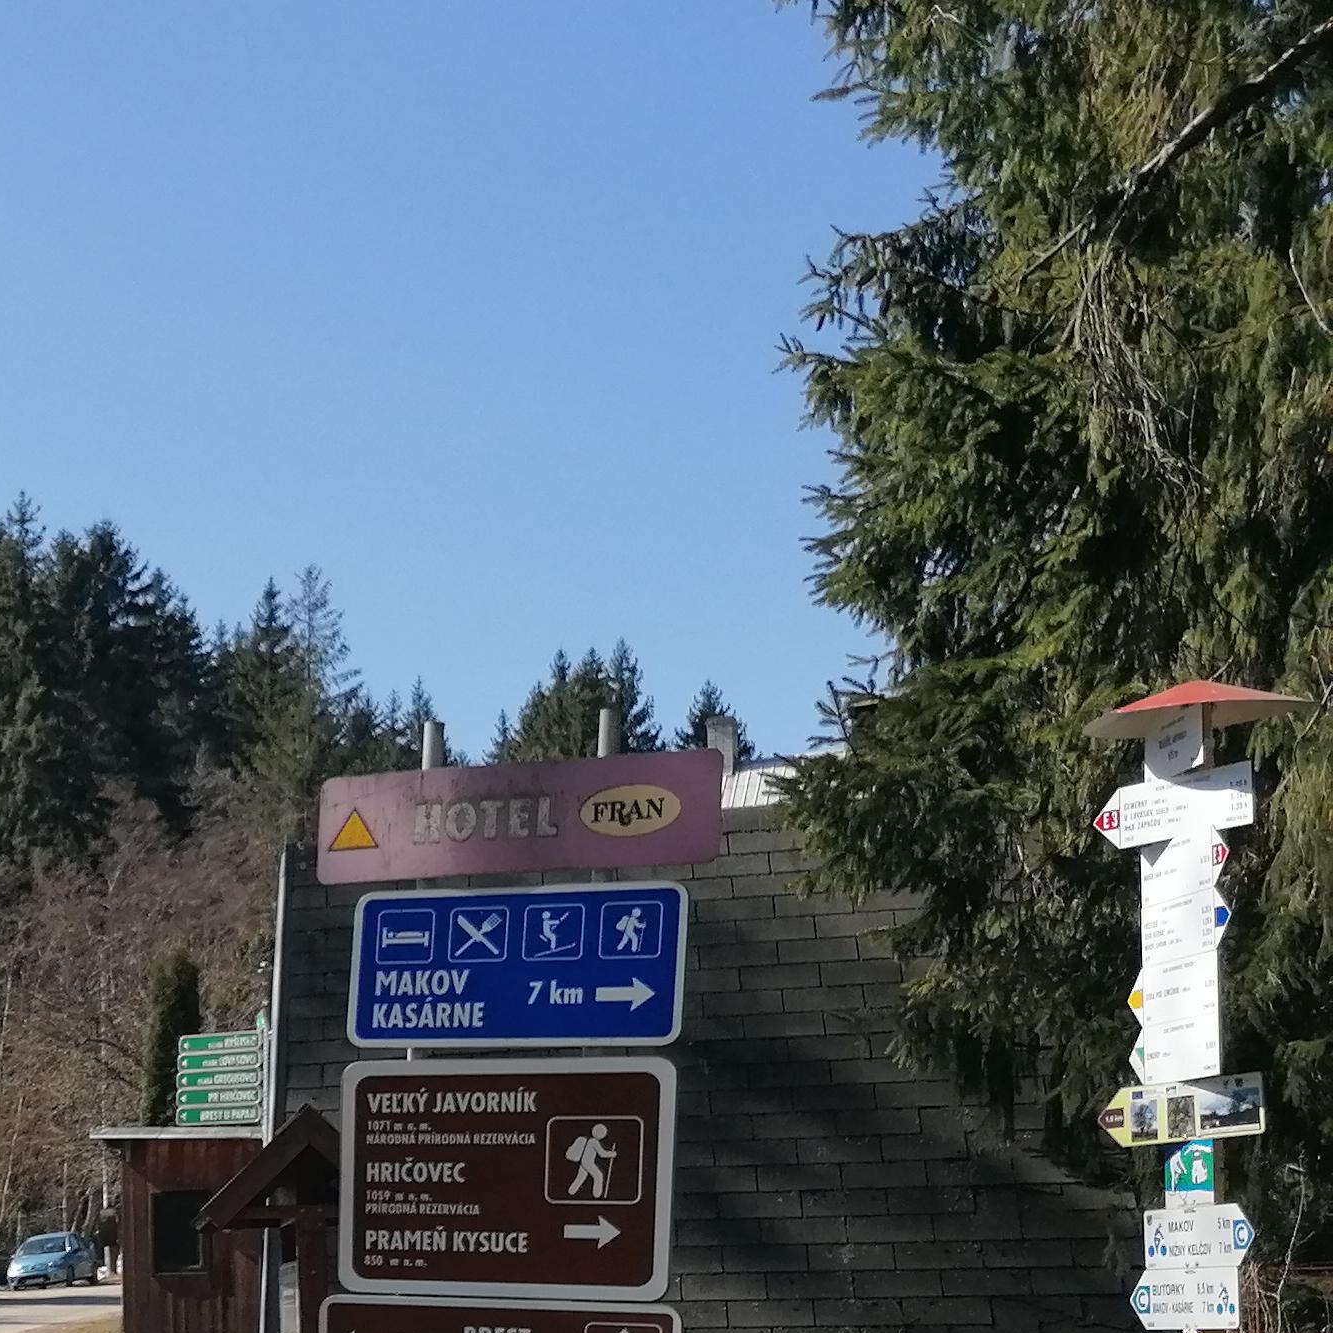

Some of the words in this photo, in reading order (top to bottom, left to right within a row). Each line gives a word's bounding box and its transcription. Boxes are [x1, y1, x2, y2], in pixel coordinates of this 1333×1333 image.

[413, 795, 559, 846] HOTEL
[590, 797, 666, 827] FRAN
[374, 969, 471, 997] MAKOV
[528, 981, 542, 1005] 7
[549, 981, 584, 1006] km
[371, 999, 485, 1030] KASÁRNE
[366, 1087, 429, 1114] VEĽKÝ
[432, 1086, 538, 1113] JAVORNÍK
[367, 1119, 391, 1131] 1071
[393, 1122, 403, 1131] m
[473, 1131, 536, 1145] REZERVÁCIA
[366, 1156, 468, 1183] HRIČOVEC
[394, 1192, 404, 1201] m
[419, 1202, 480, 1215] REZERVÁCIA
[1168, 1220, 1194, 1232] MAKOV
[365, 1225, 448, 1251] PRAMEŇ
[452, 1231, 530, 1253] KYSUCE
[364, 1254, 384, 1266] 850
[389, 1257, 400, 1266] m
